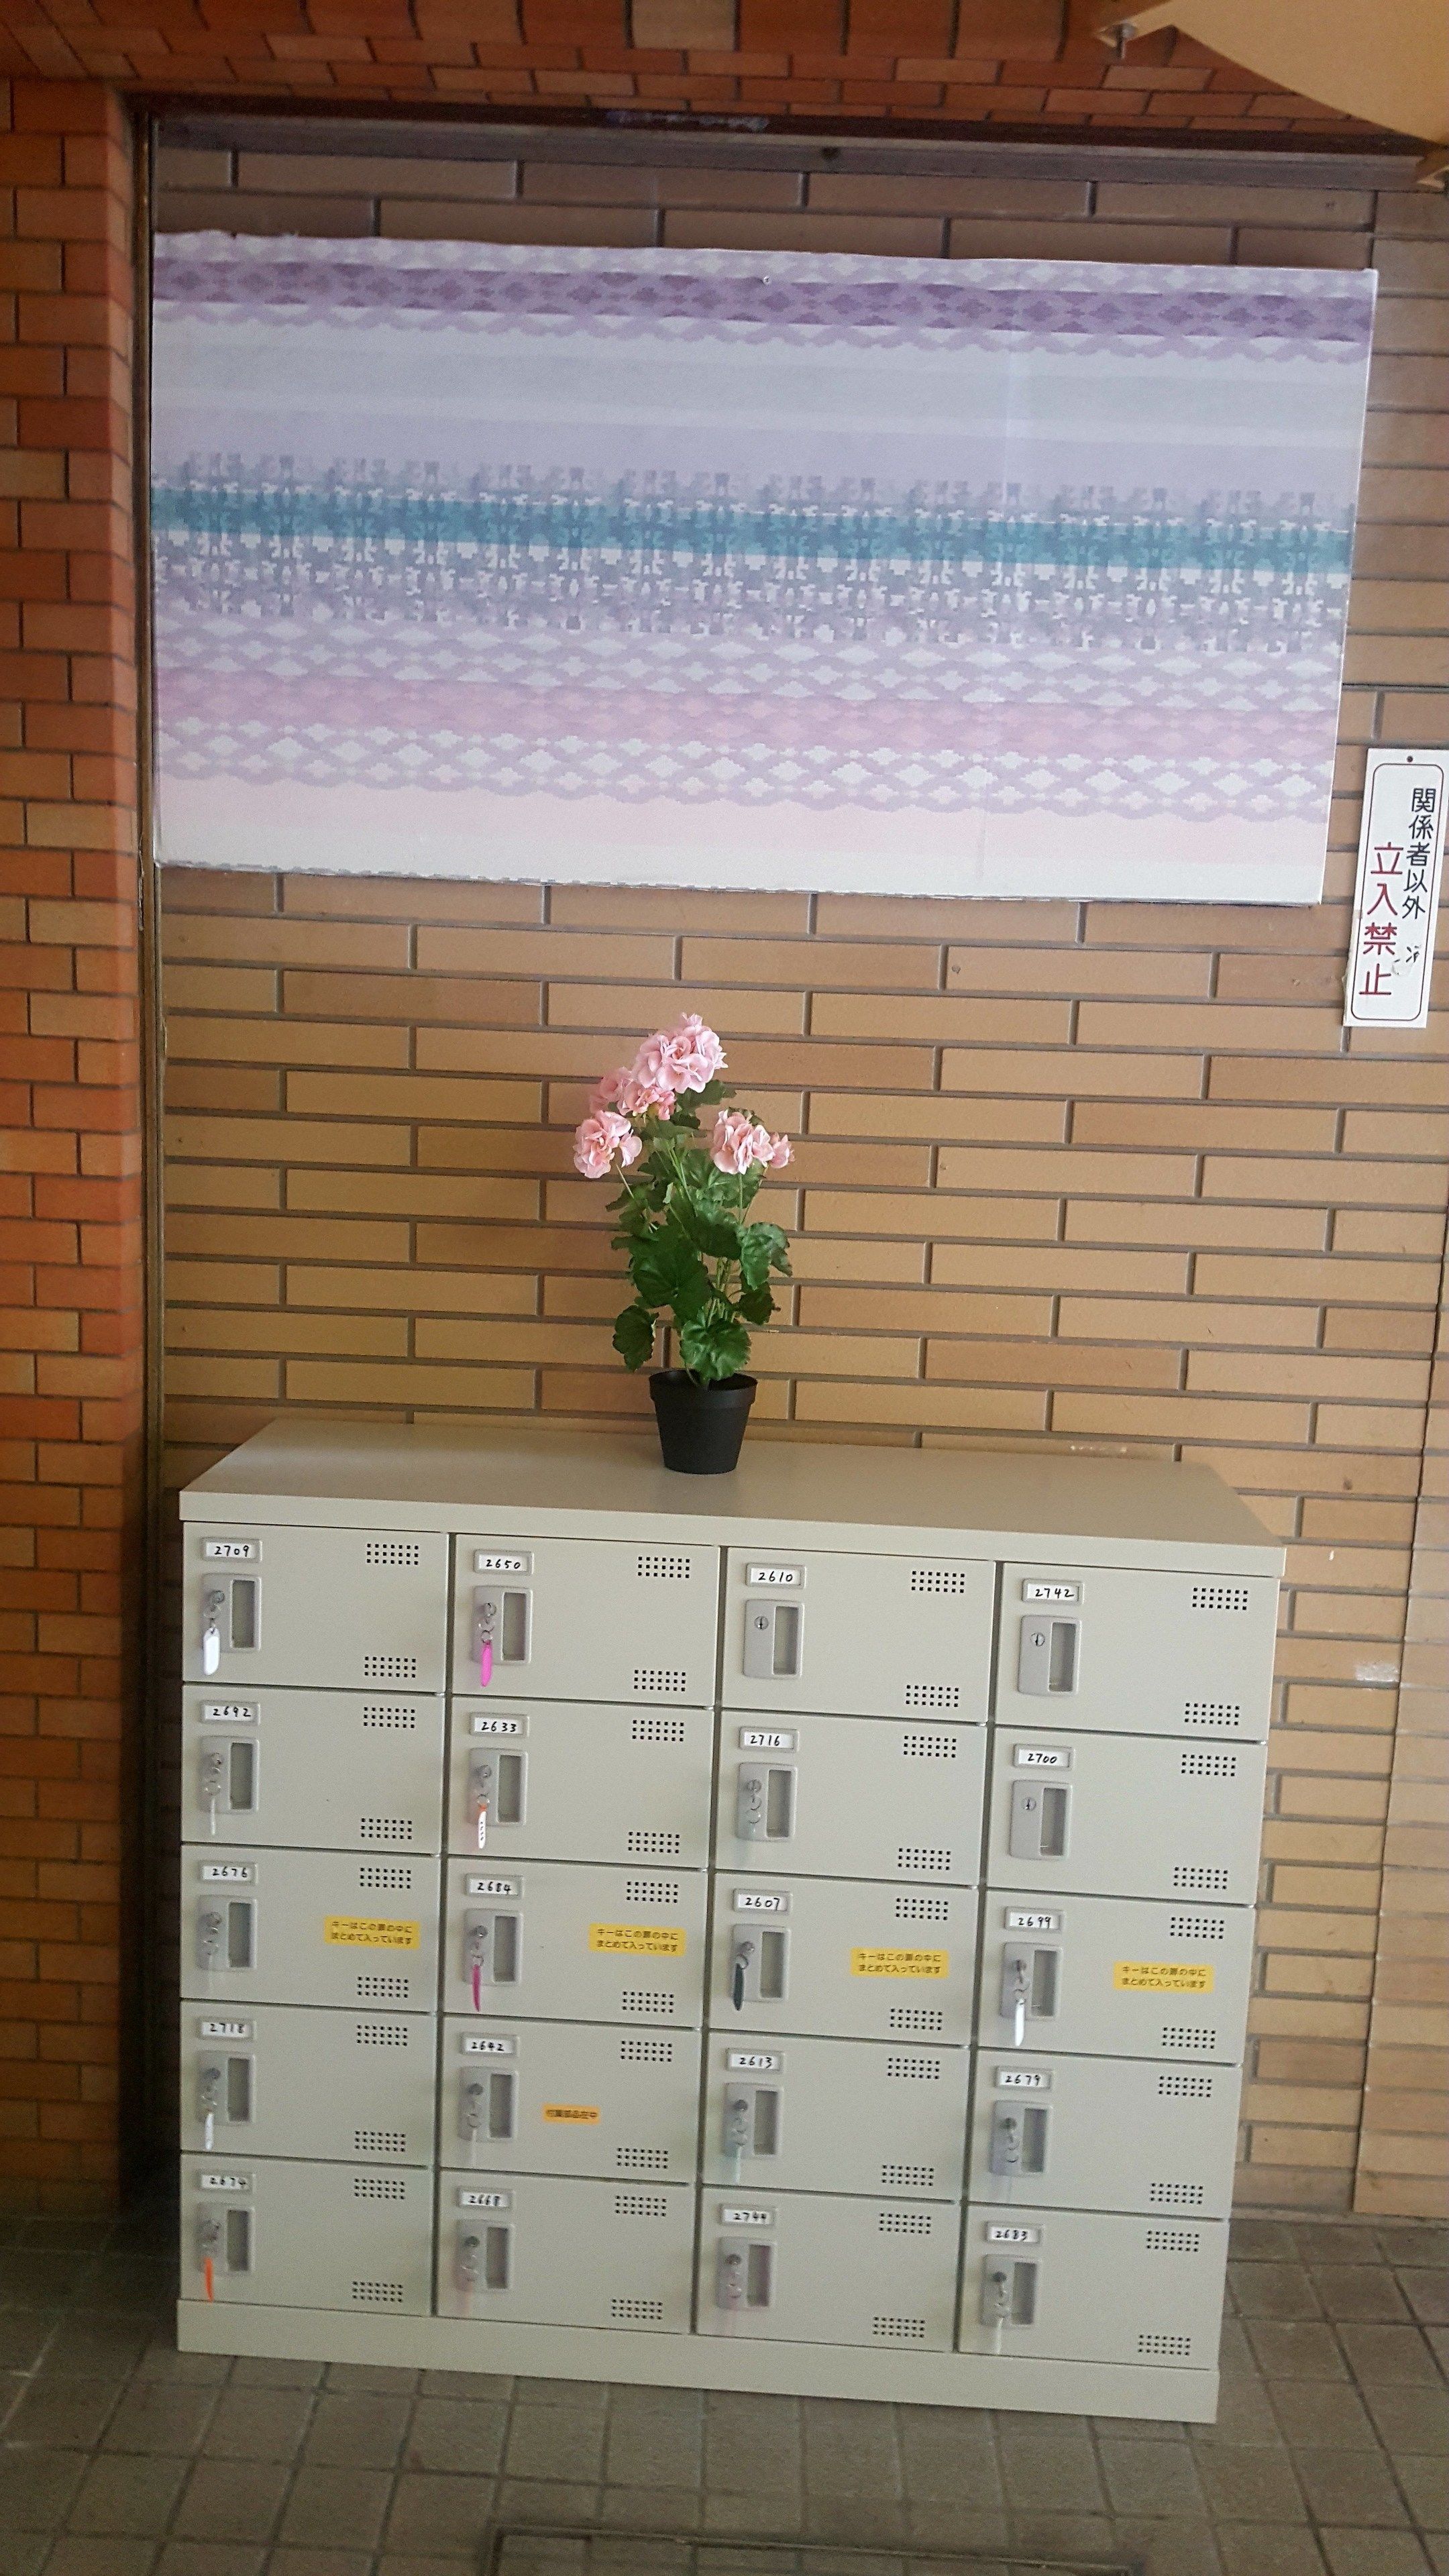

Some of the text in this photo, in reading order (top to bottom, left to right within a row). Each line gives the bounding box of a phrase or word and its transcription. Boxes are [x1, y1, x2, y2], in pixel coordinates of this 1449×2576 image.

[1401, 787, 1437, 920] 関係者以外
[1358, 841, 1404, 996] 立入禁止
[213, 1545, 250, 1558] 2709
[485, 1558, 521, 1570] 2650
[757, 1571, 794, 1583] 2610
[1034, 1587, 1075, 1599] 2742
[212, 1707, 252, 1718] 2692
[480, 1721, 517, 1733] 2633
[749, 1734, 780, 1747] 2716
[1027, 1752, 1058, 1764] 2700
[212, 1867, 248, 1878] 2676
[477, 1881, 512, 1893] 2684
[744, 1896, 781, 1909] 2607
[1018, 1915, 1052, 1929] 2699
[739, 2056, 773, 2068] 2613
[1004, 2074, 1041, 2086] 2679
